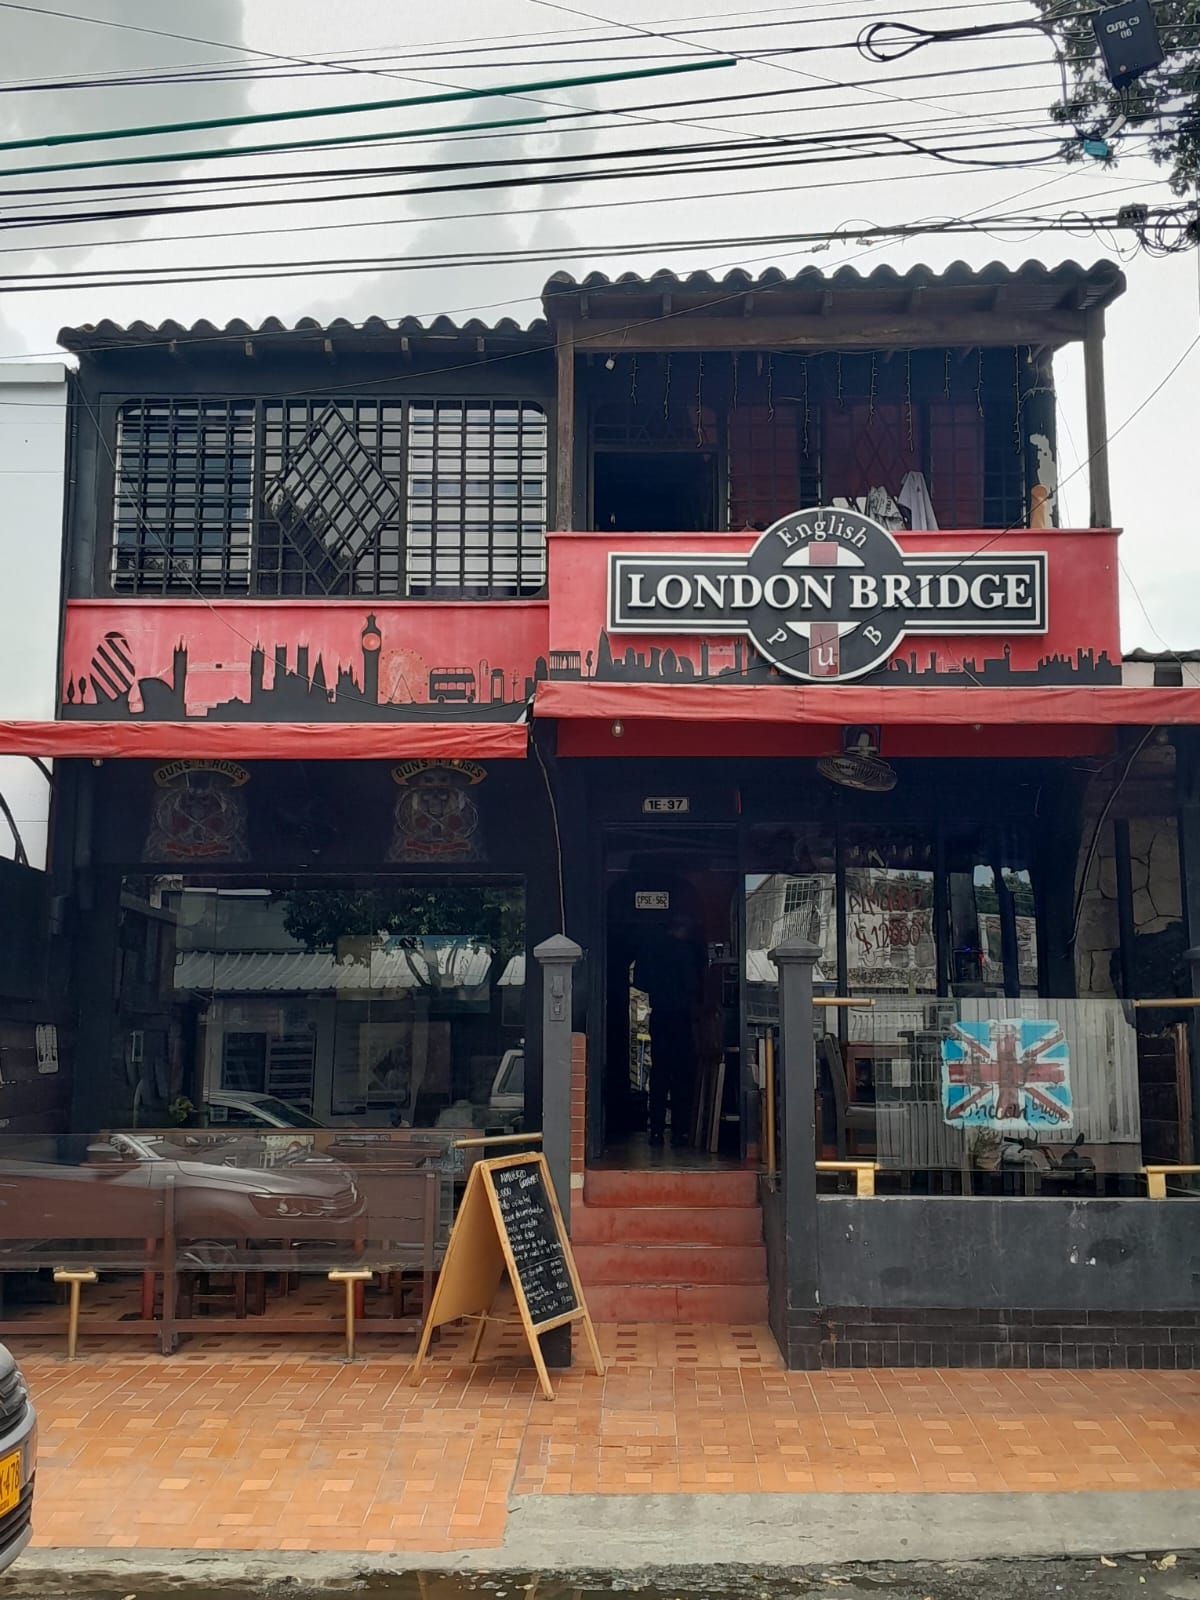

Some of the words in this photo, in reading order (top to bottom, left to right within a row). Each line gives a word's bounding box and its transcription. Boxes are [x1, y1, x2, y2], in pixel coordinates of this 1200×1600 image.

[777, 514, 868, 549] English
[627, 574, 836, 609] LONDON
[849, 573, 1034, 609] BRIDGE
